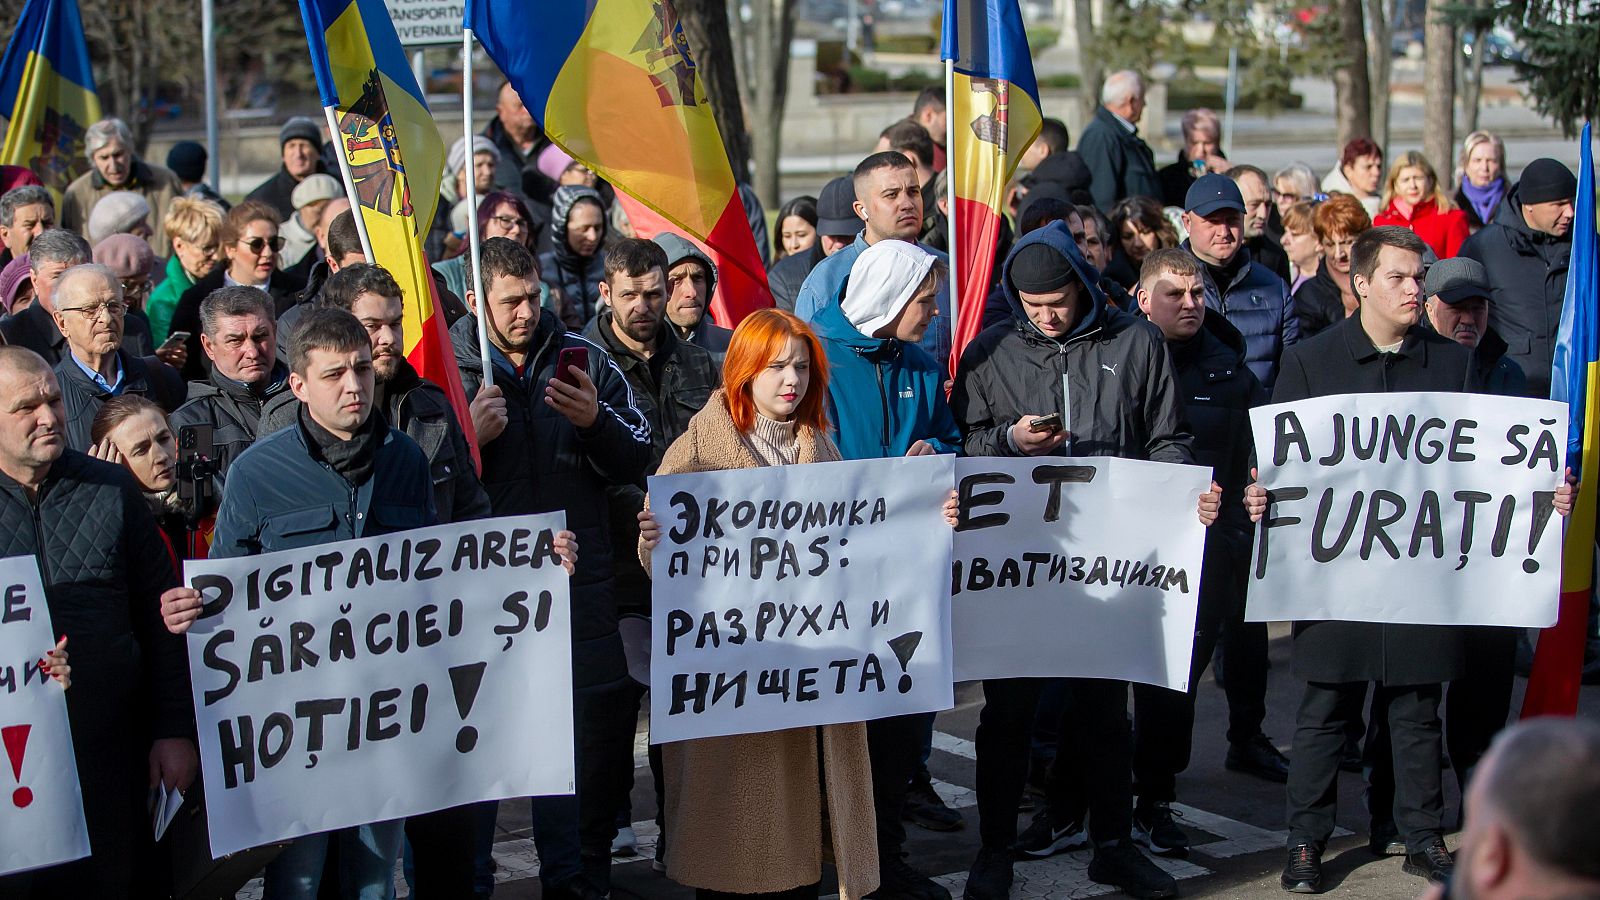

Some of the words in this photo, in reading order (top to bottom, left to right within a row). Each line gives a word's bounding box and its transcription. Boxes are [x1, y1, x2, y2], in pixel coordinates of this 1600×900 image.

[1501, 418, 1559, 472] SĂ
[668, 491, 887, 545] ЭКОНОМИКА
[1255, 486, 1557, 580] FURAȚI!
[750, 536, 849, 581] PAS:
[202, 598, 463, 706] SĂRĂCIEI
[493, 589, 552, 651] ȘI
[666, 600, 850, 656] РАЗРУХА
[668, 631, 924, 716] НИЩЕТА!
[217, 661, 488, 789] HOȚIEI!
